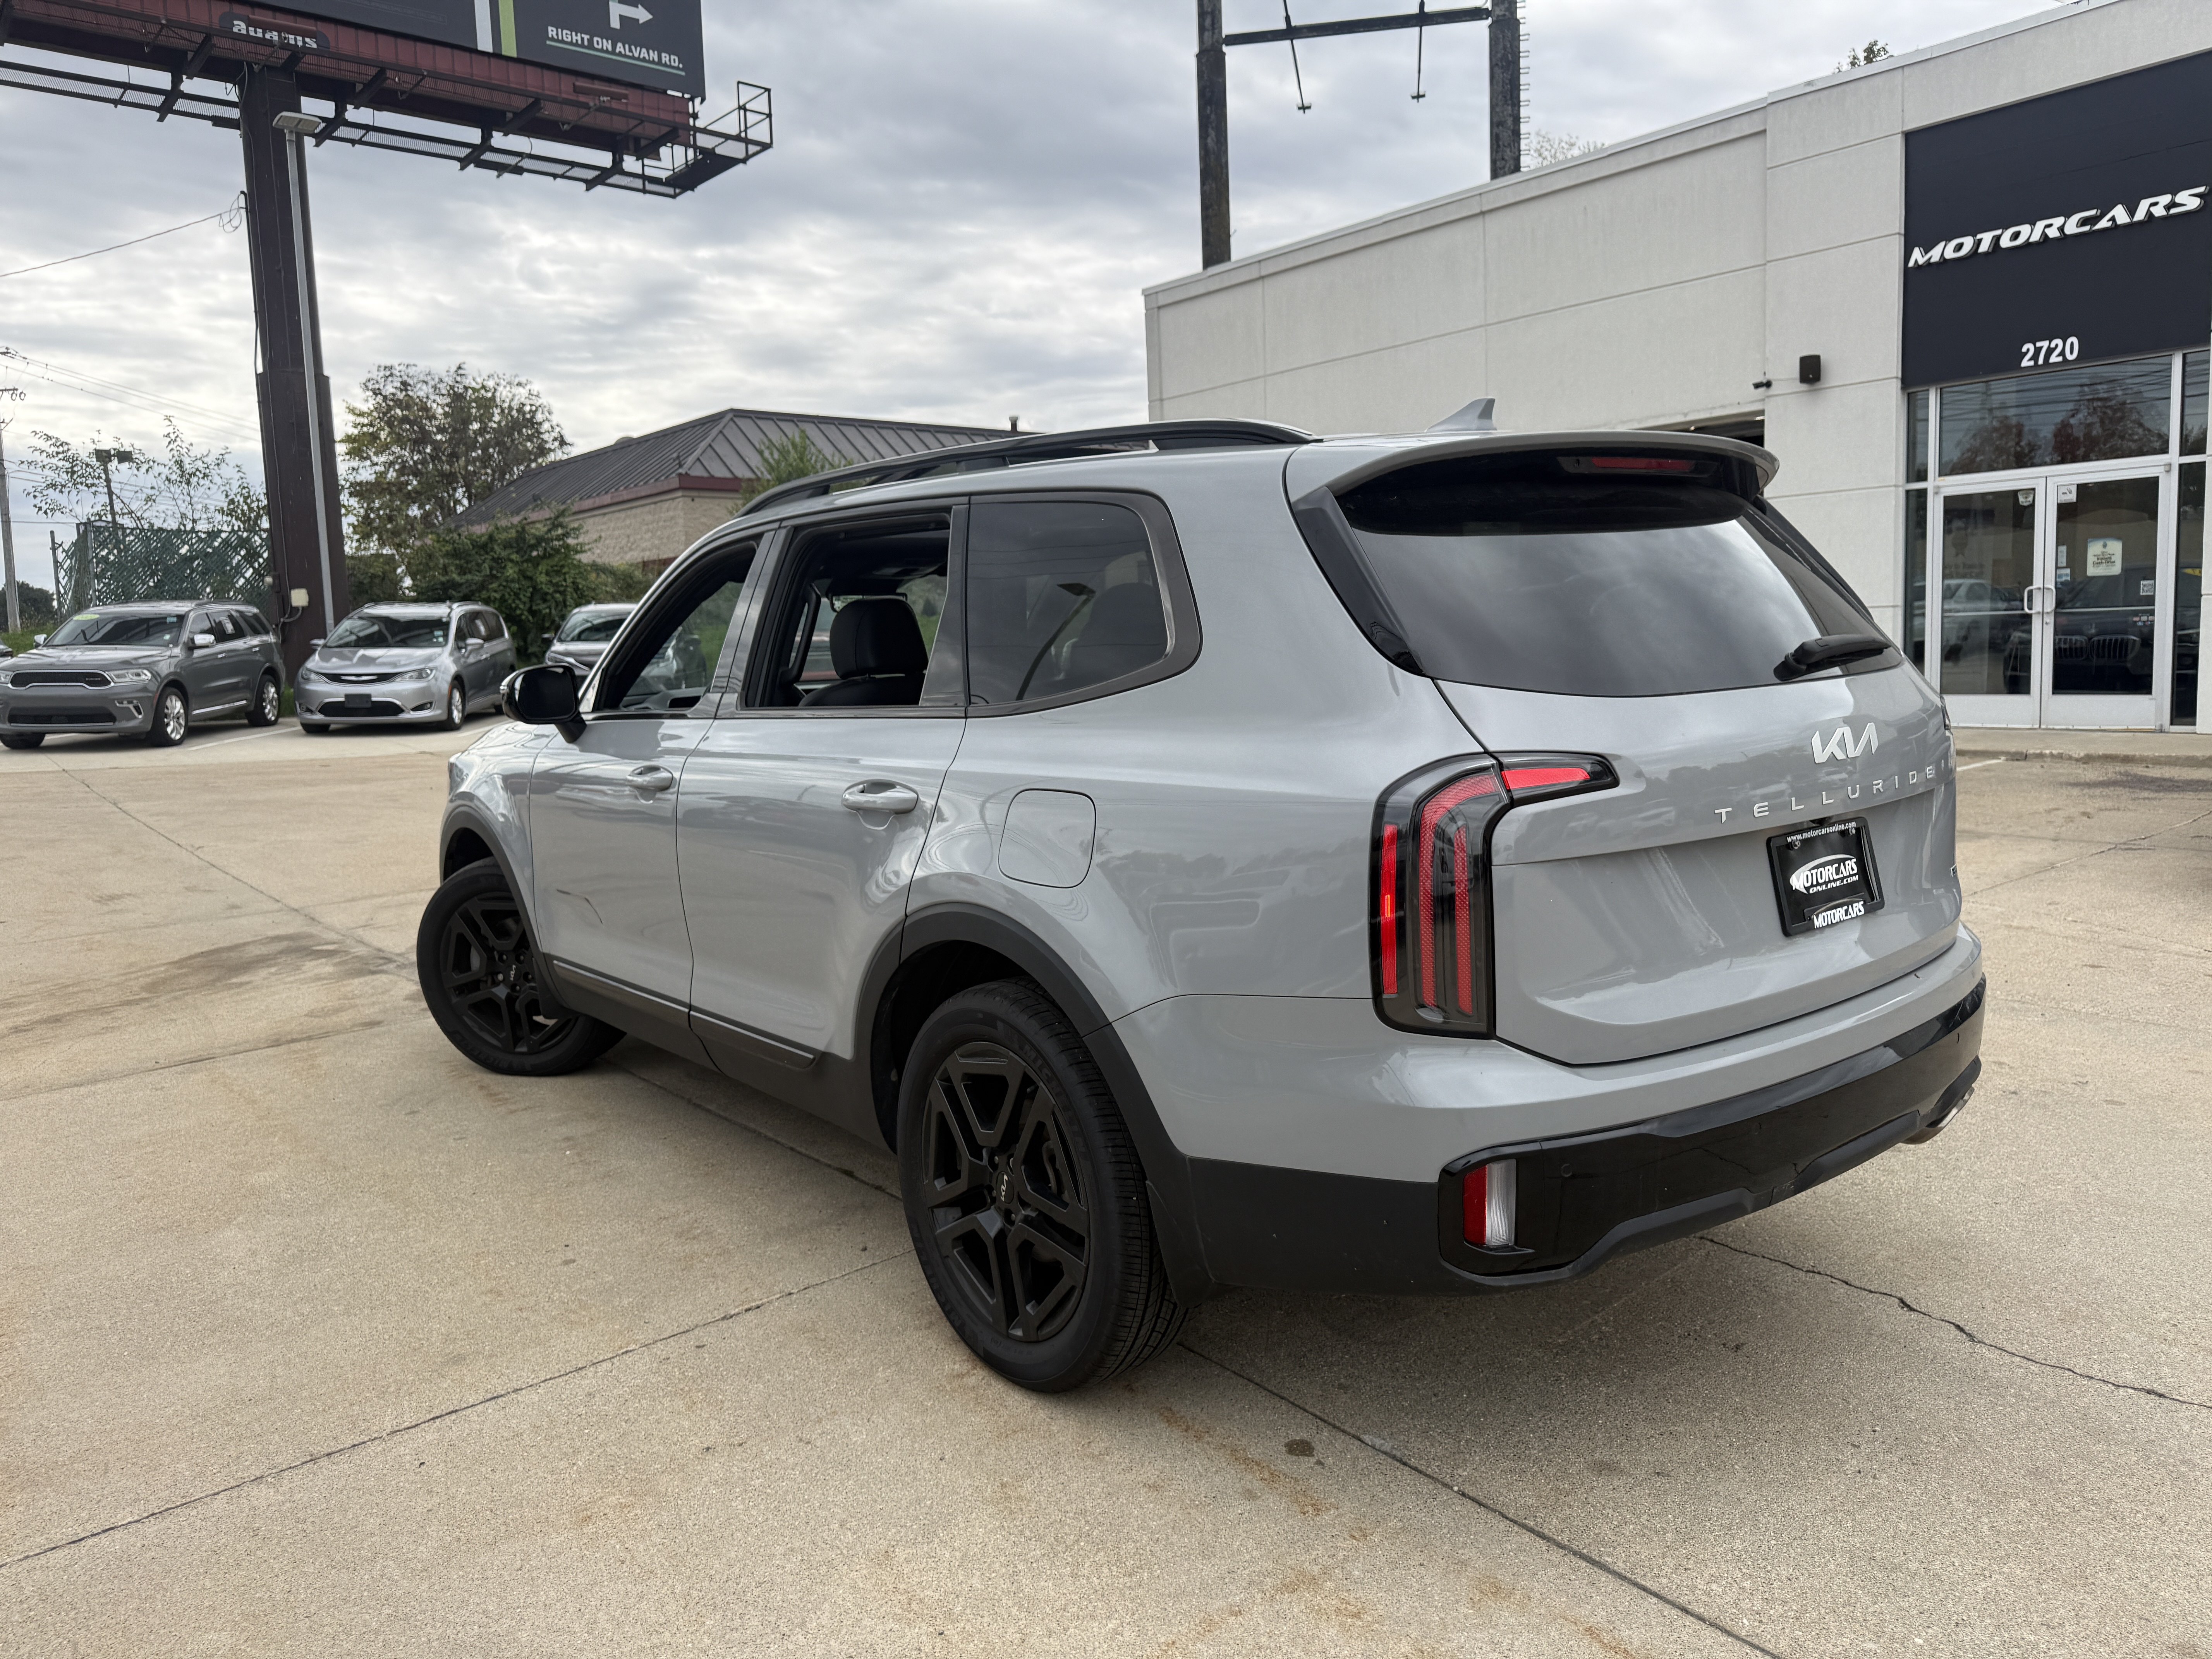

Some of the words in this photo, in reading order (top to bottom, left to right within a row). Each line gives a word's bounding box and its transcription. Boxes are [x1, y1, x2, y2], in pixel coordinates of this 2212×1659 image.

[548, 26, 590, 46] RIGHT
[593, 36, 612, 52] ON
[615, 42, 658, 62] ALVAN
[661, 52, 683, 68] RD.
[1908, 185, 2209, 268] MOTORCARS
[2020, 336, 2080, 368] 2720
[1811, 722, 1879, 764] KIA
[1714, 765, 1936, 824] TELLURIDE
[1787, 821, 1856, 843] www.motorcarsonline.com
[1792, 859, 1857, 890] MOTORCARS
[1809, 875, 1859, 894] ONLINE.COM
[1813, 901, 1865, 929] MOTORCARS
